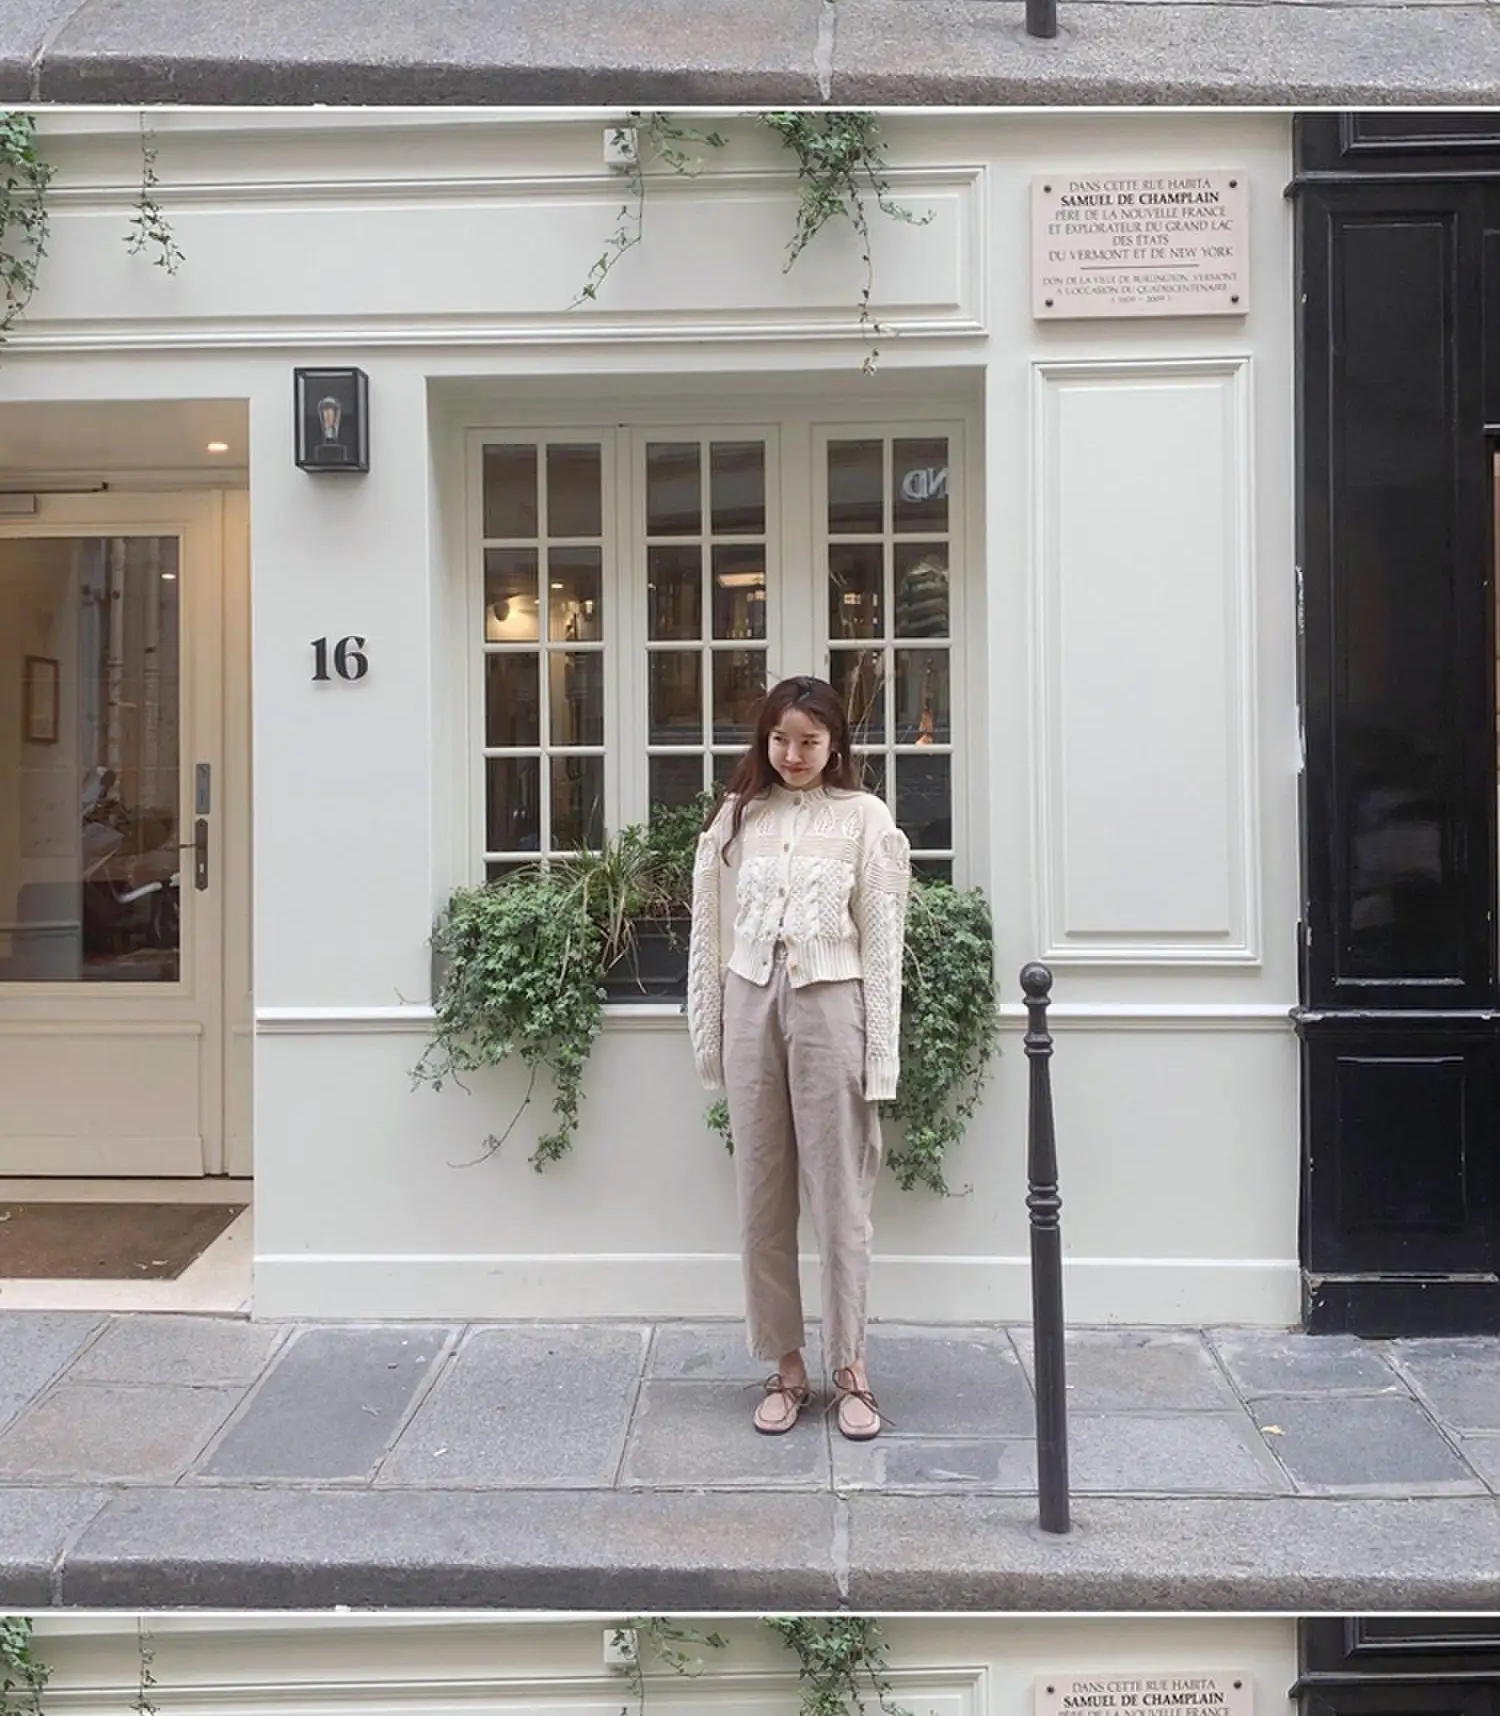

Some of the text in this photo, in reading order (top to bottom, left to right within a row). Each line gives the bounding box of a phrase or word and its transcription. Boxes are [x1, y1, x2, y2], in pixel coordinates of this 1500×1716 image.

[1060, 192, 1219, 206] SAMUEL DE CHAMPLAIN
[1112, 236, 1133, 246] DES
[1048, 246, 1233, 262] DU VERMONT ET DE NEW YORK
[310, 635, 368, 681] 16
[1064, 1692, 1224, 1707] SAMUEL DE CHAMPLAIN
